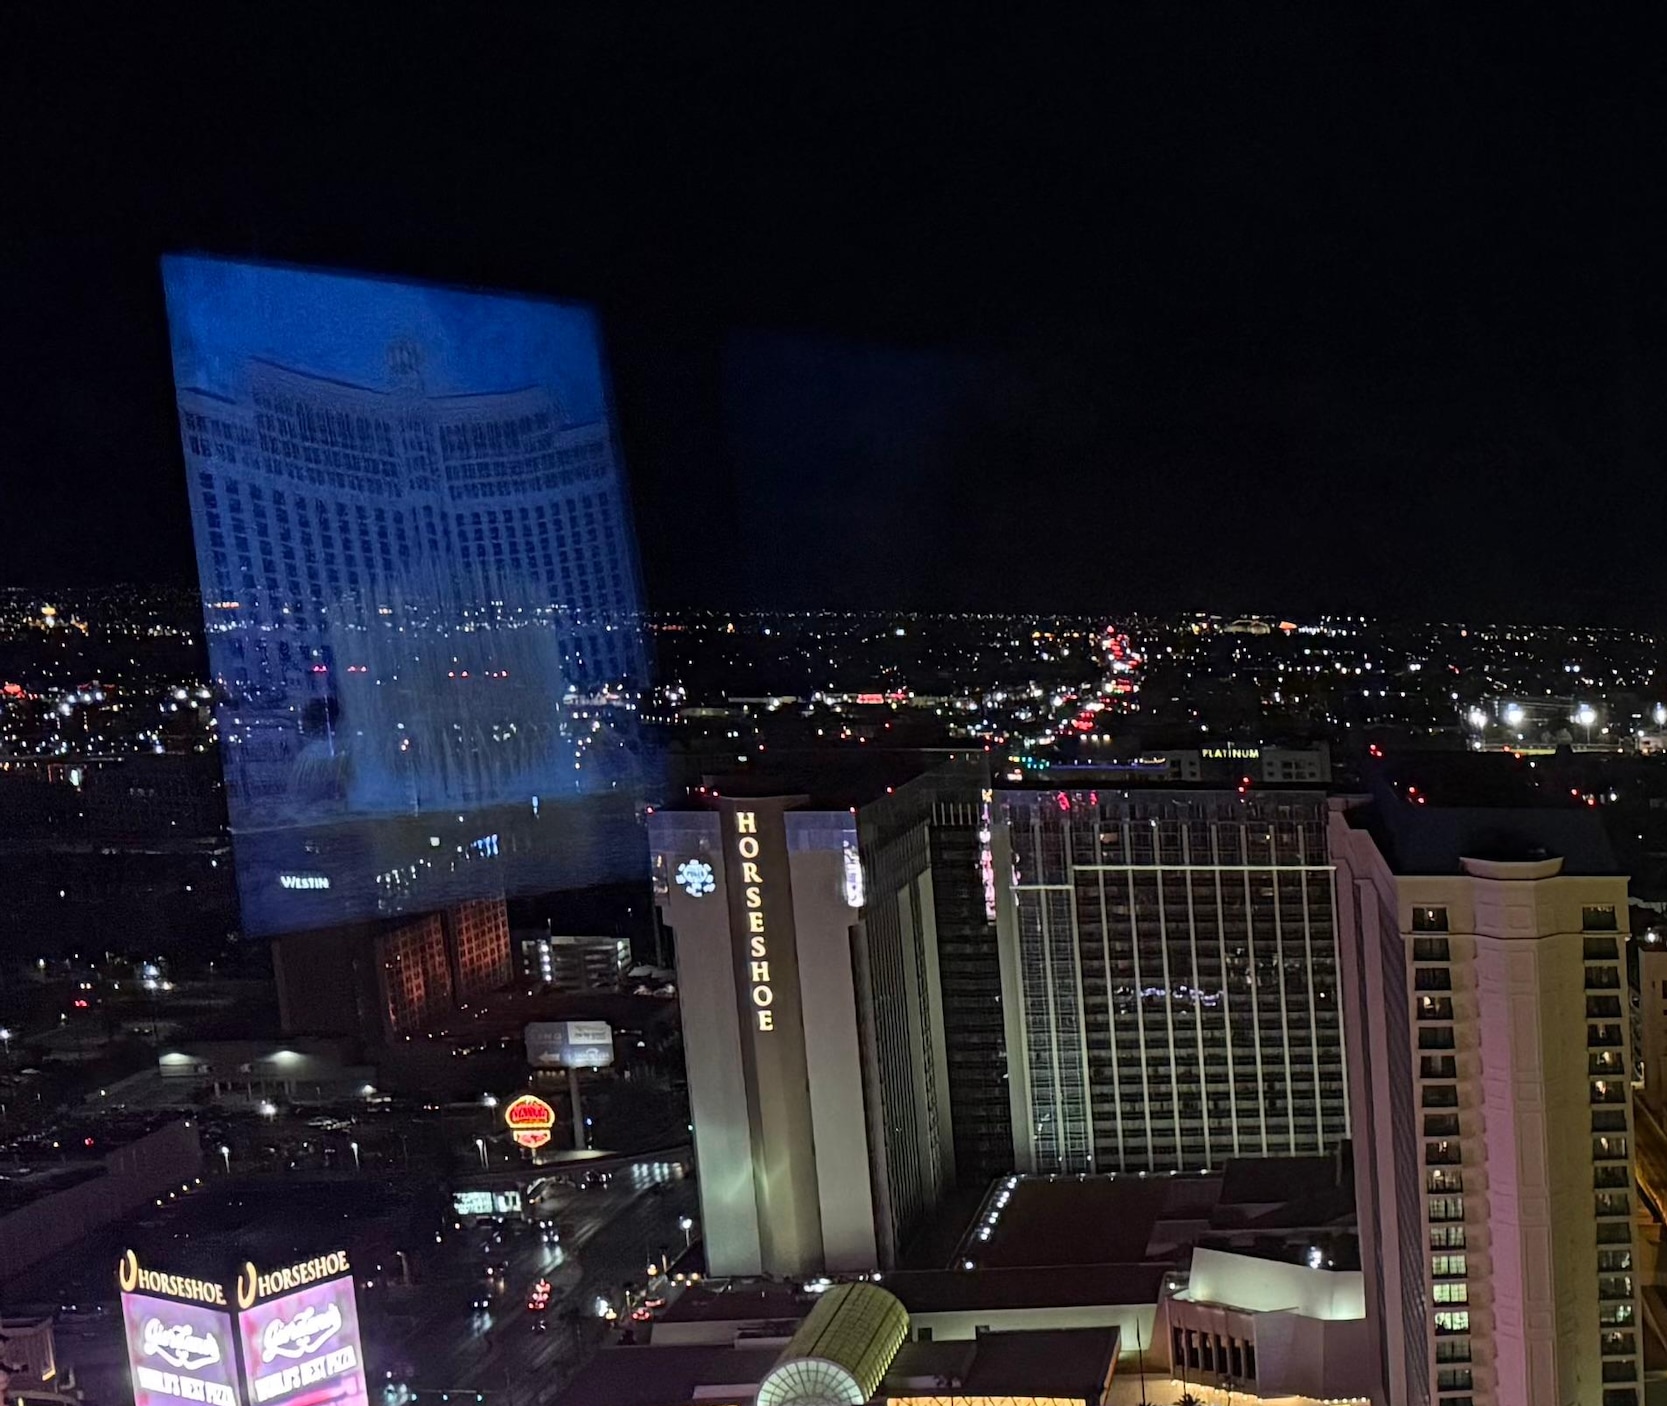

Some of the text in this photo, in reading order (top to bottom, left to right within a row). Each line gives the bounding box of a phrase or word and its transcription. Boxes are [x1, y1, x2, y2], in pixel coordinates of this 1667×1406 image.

[1202, 748, 1259, 758] PLATINUM
[736, 811, 774, 1032] HORSESHOE
[138, 1268, 227, 1306] HORSESHOE
[257, 1250, 350, 1297] HORSESHOE
